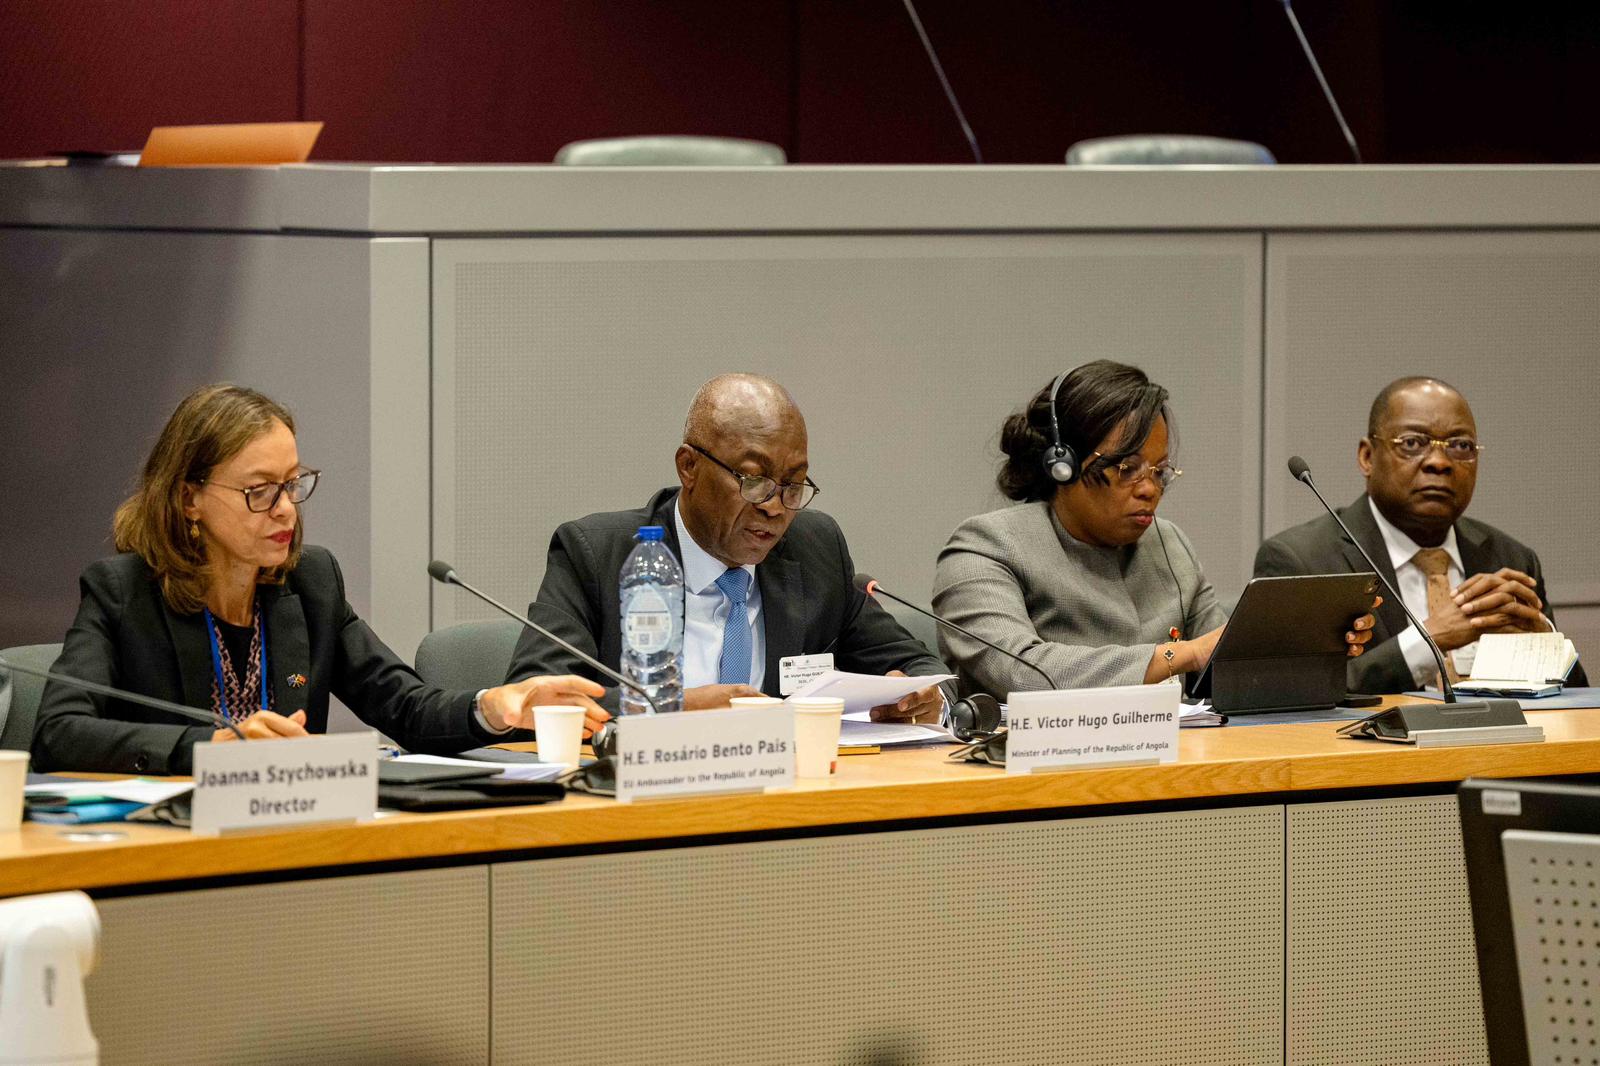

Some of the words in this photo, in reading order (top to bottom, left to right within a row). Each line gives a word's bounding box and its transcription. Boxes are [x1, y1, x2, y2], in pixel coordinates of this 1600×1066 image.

[1011, 718, 1033, 730] H.E.
[1037, 716, 1074, 729] Victor
[1078, 714, 1108, 729] Hugo
[1112, 711, 1173, 725] Guilherme
[623, 752, 649, 766] H.E.
[654, 746, 707, 763] Rosário
[713, 743, 753, 758] Bento
[758, 738, 787, 754] Pais
[1011, 750, 1040, 758] Minister
[1051, 747, 1081, 757] Planning
[1083, 746, 1091, 754] of
[1092, 745, 1104, 753] the
[1106, 744, 1134, 753] Republic
[1136, 743, 1144, 751] of
[1145, 741, 1169, 751] Angola
[199, 769, 260, 788] Joanna
[266, 761, 369, 786] Szychowska
[637, 777, 685, 788] Ambassador
[687, 776, 695, 784] to
[697, 774, 711, 783] the
[714, 771, 745, 781] Republic
[748, 769, 757, 777] of
[759, 767, 785, 778] Angola
[249, 798, 316, 816] Director
